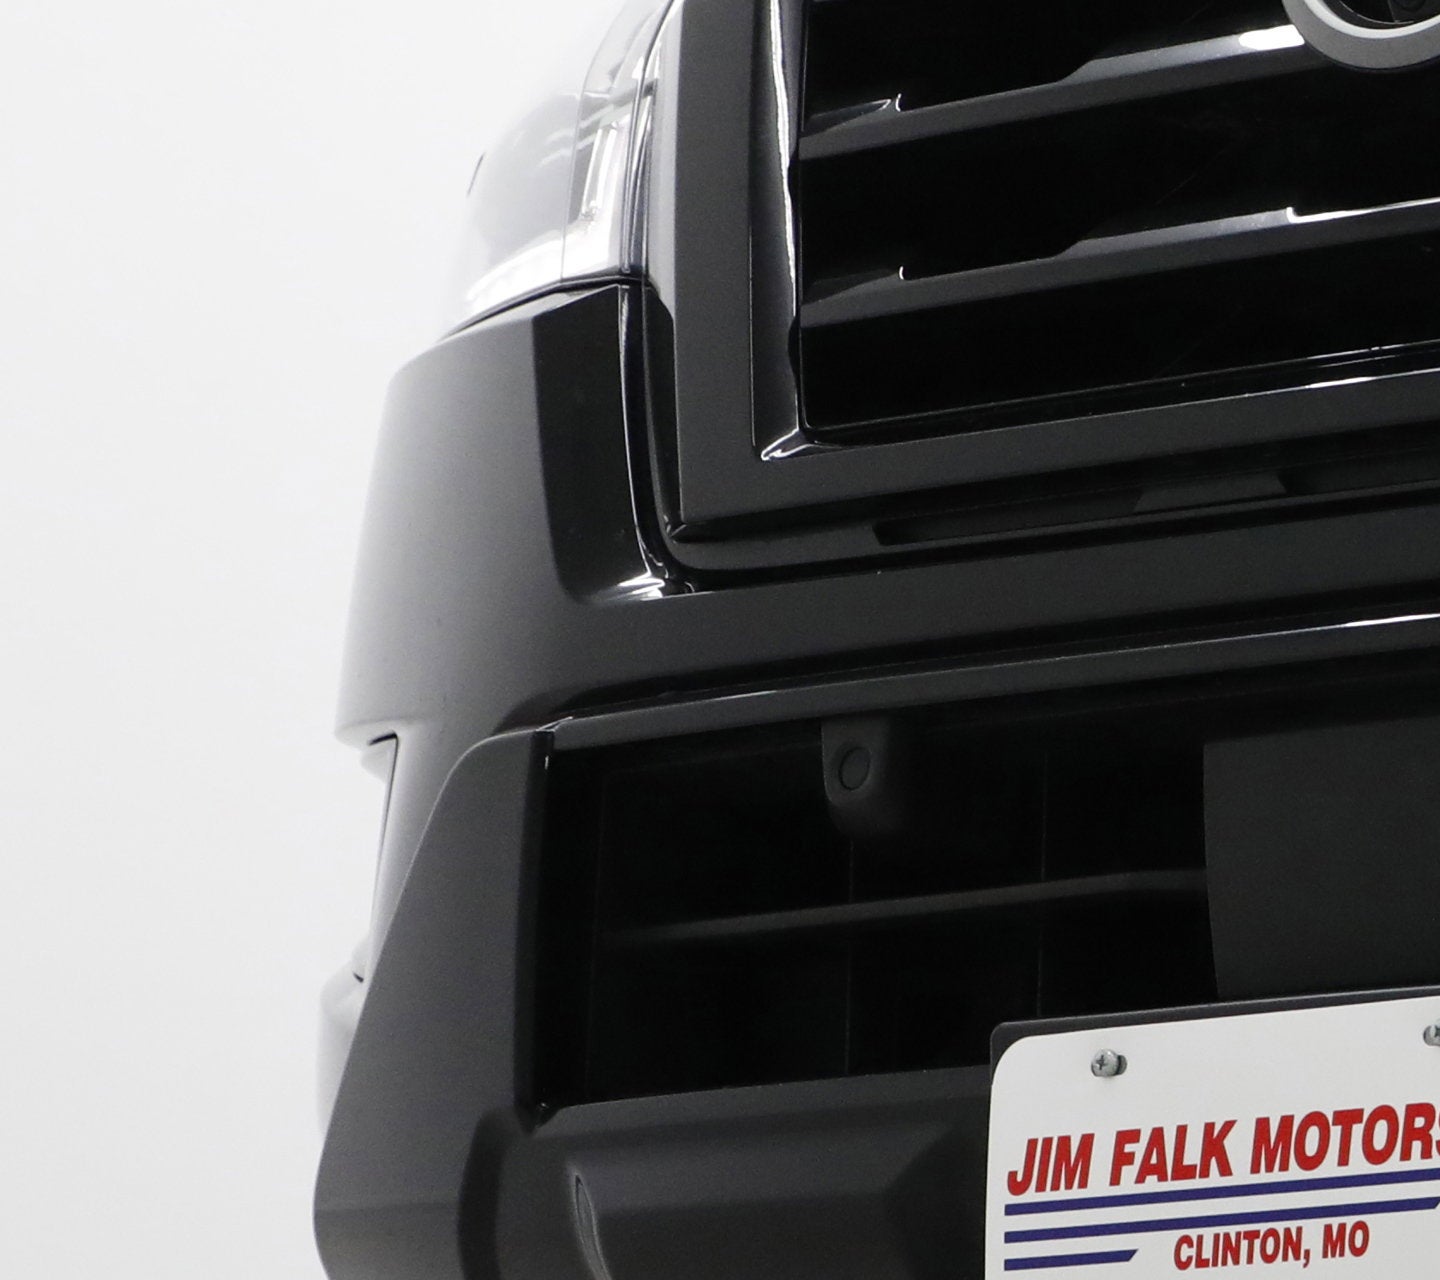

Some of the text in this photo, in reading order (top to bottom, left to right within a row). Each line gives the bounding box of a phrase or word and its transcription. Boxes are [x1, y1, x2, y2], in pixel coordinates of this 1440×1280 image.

[1006, 1133, 1095, 1196] JIM
[1108, 1119, 1238, 1187] FALK
[1173, 1220, 1370, 1271] CLINTON, MO
